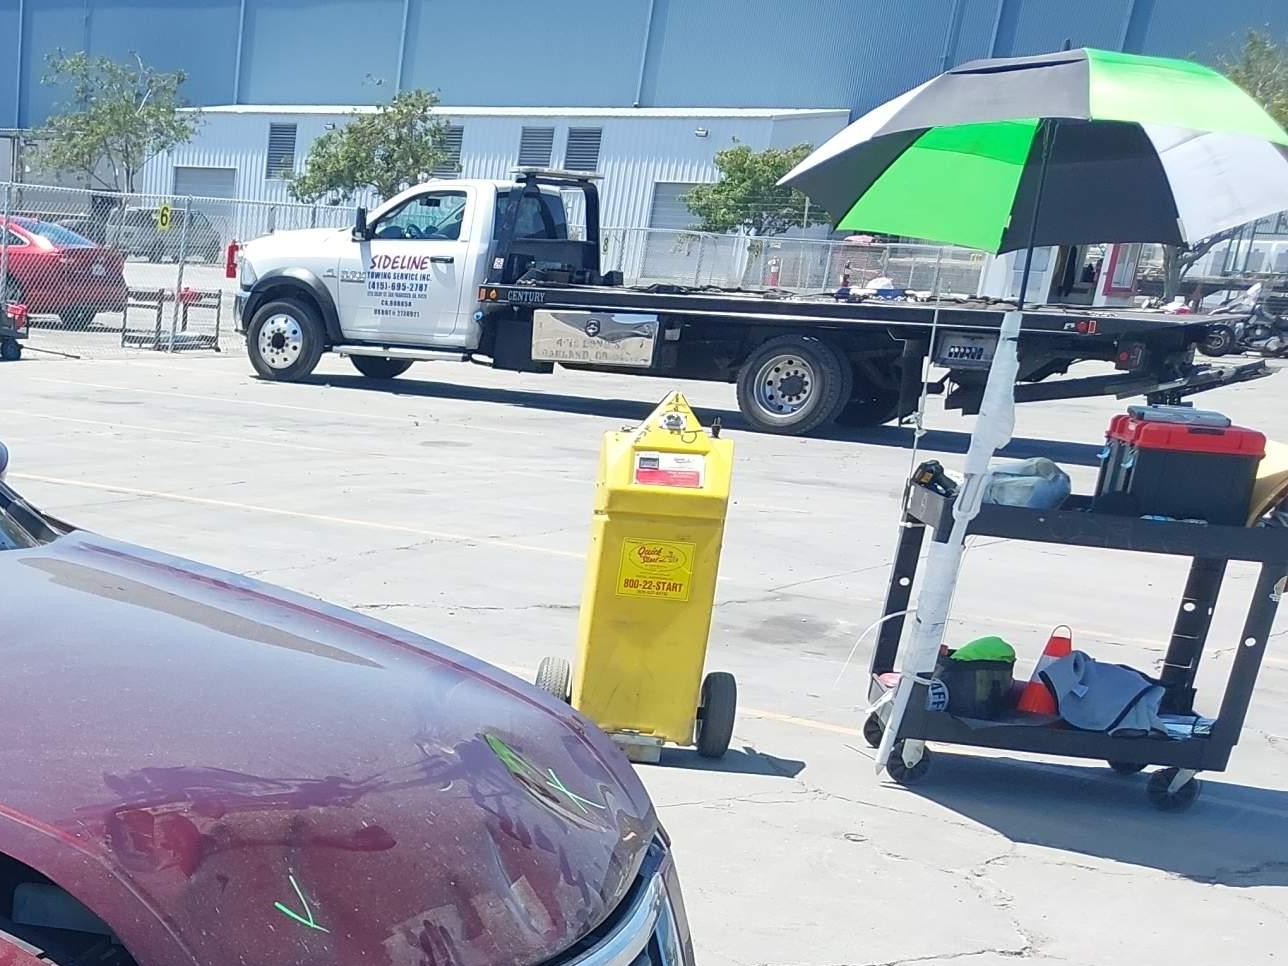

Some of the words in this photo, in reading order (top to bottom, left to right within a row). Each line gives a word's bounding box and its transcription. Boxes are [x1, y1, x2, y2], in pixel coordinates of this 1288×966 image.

[160, 206, 169, 227] 6
[370, 255, 430, 271] SIDELINE
[367, 271, 392, 280] TOWING
[392, 271, 418, 281] SERVICE
[368, 281, 428, 292] (415)-695-2787
[507, 290, 546, 303] CENTURY
[623, 578, 684, 593] 800-22-START
